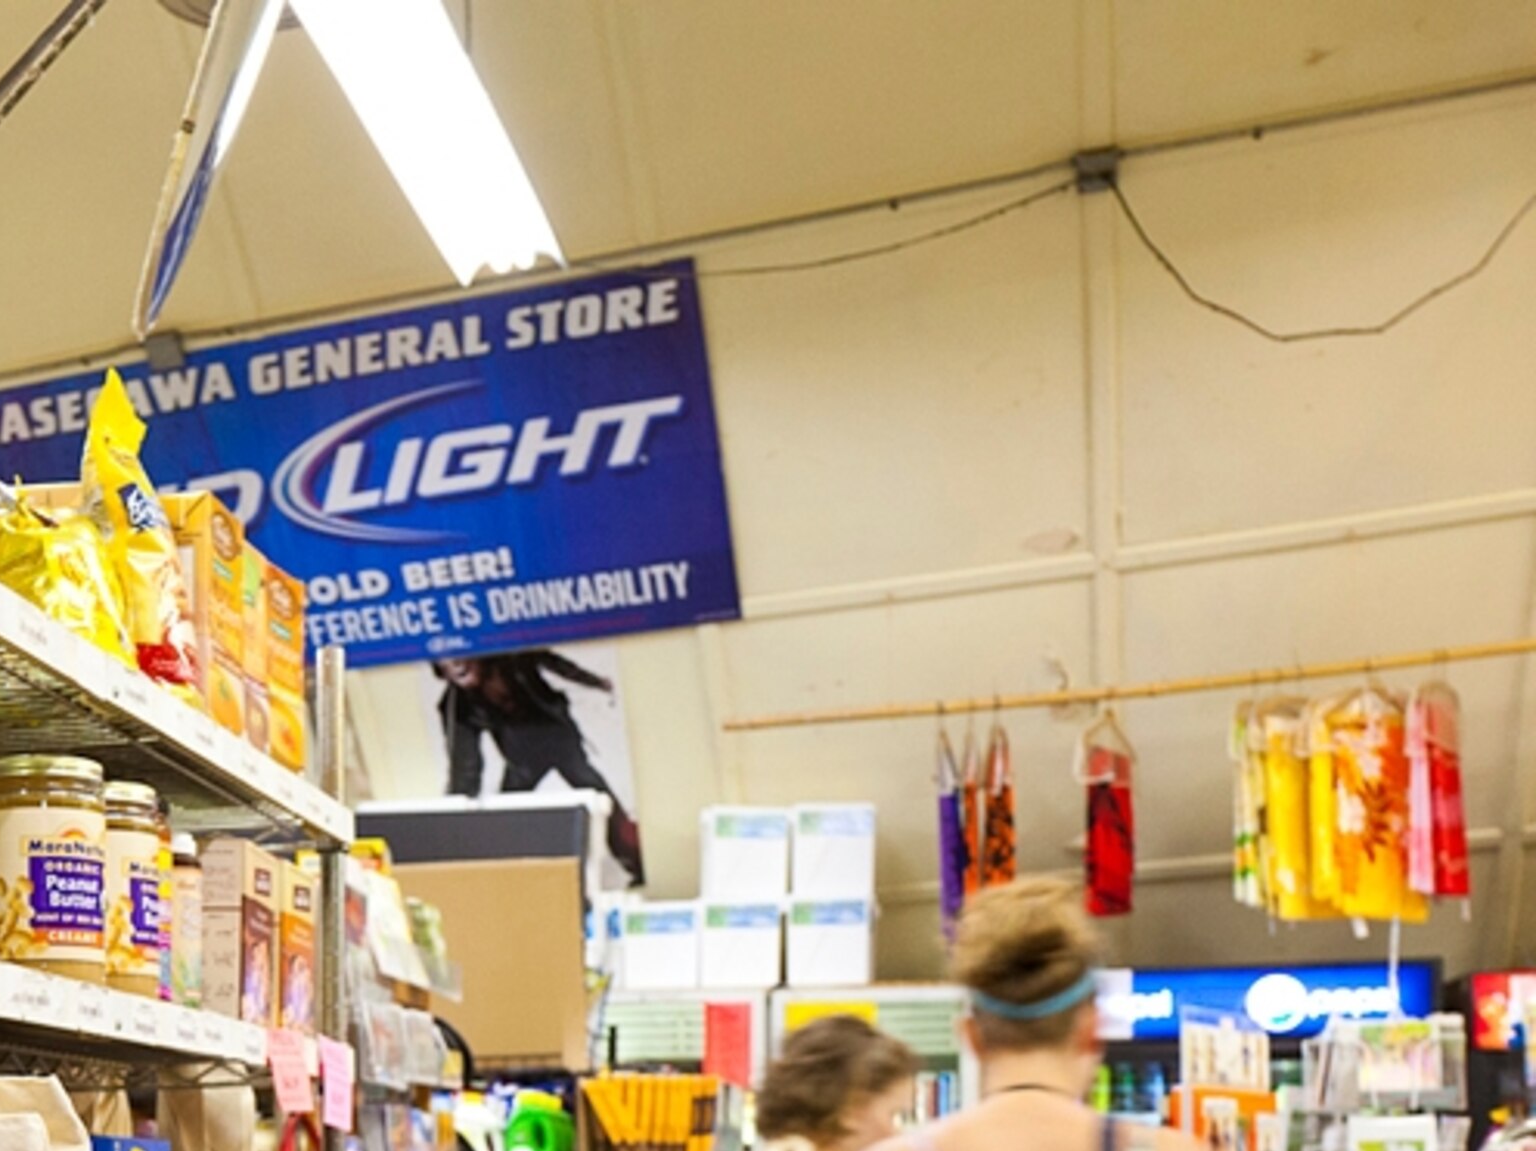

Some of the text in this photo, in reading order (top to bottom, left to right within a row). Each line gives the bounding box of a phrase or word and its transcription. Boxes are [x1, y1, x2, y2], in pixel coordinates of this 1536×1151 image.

[247, 315, 491, 397] GENERAL
[504, 278, 680, 350] STORE
[322, 395, 684, 516] LIGHT
[306, 560, 691, 648] FERENCE IS DRINKABILITY
[307, 569, 390, 607] OLD
[401, 546, 514, 594] BEER!
